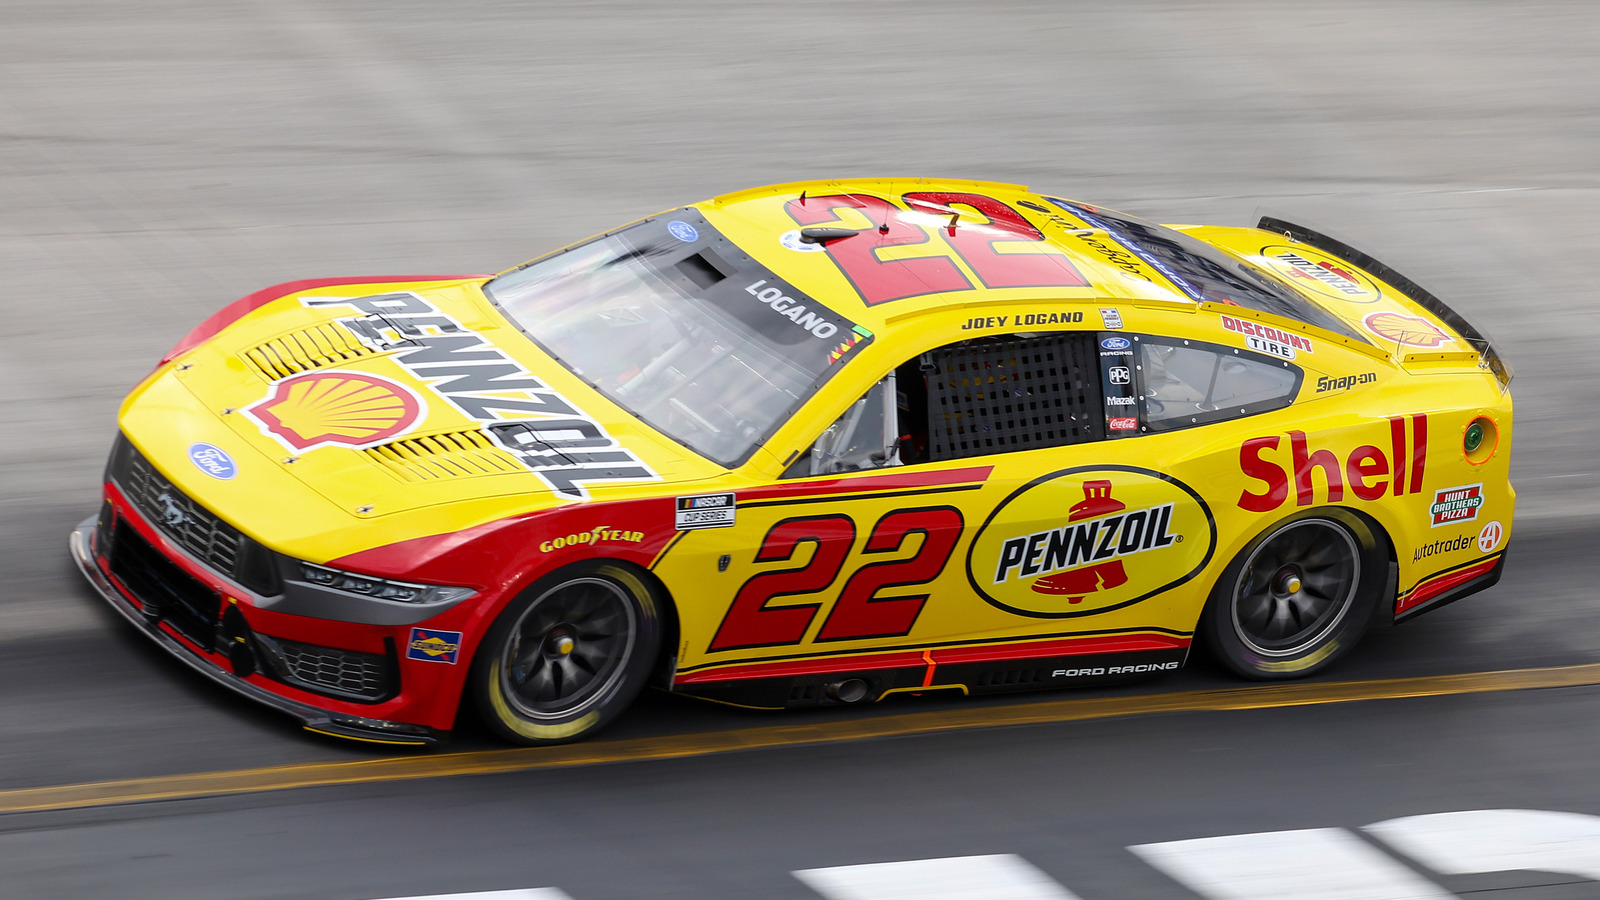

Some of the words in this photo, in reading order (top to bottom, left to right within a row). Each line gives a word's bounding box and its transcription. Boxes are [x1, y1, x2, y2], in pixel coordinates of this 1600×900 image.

[784, 192, 1092, 307] 22
[1274, 250, 1371, 296] PENNZOIL
[745, 280, 838, 339] LOGANO
[961, 316, 1008, 330] JOEY
[1014, 312, 1084, 326] LOGANO
[1104, 338, 1128, 349] Ford
[1221, 315, 1313, 353] DISCOUNT
[1250, 338, 1290, 357] TIRE
[1109, 368, 1129, 383] PPG
[1316, 372, 1377, 393] Snap-on
[302, 291, 659, 499] PENNZOIL
[1107, 396, 1135, 406] Mazak
[1109, 418, 1136, 430] Coca-Cola
[190, 446, 233, 476] Ford
[1237, 413, 1428, 513] Shell
[690, 496, 728, 508] NASCAR
[1433, 498, 1480, 513] BROTHERS
[1444, 490, 1471, 503] HUNT
[684, 512, 700, 522] CUP
[700, 510, 727, 521] SERIES
[1441, 508, 1469, 520] PIZZA
[539, 526, 645, 553] GOODYEAR
[994, 503, 1176, 584] PENNZOIL
[1412, 534, 1476, 565] Autotrader
[705, 504, 965, 654] 22
[1052, 667, 1105, 678] FORD
[1108, 661, 1179, 676] RACING
